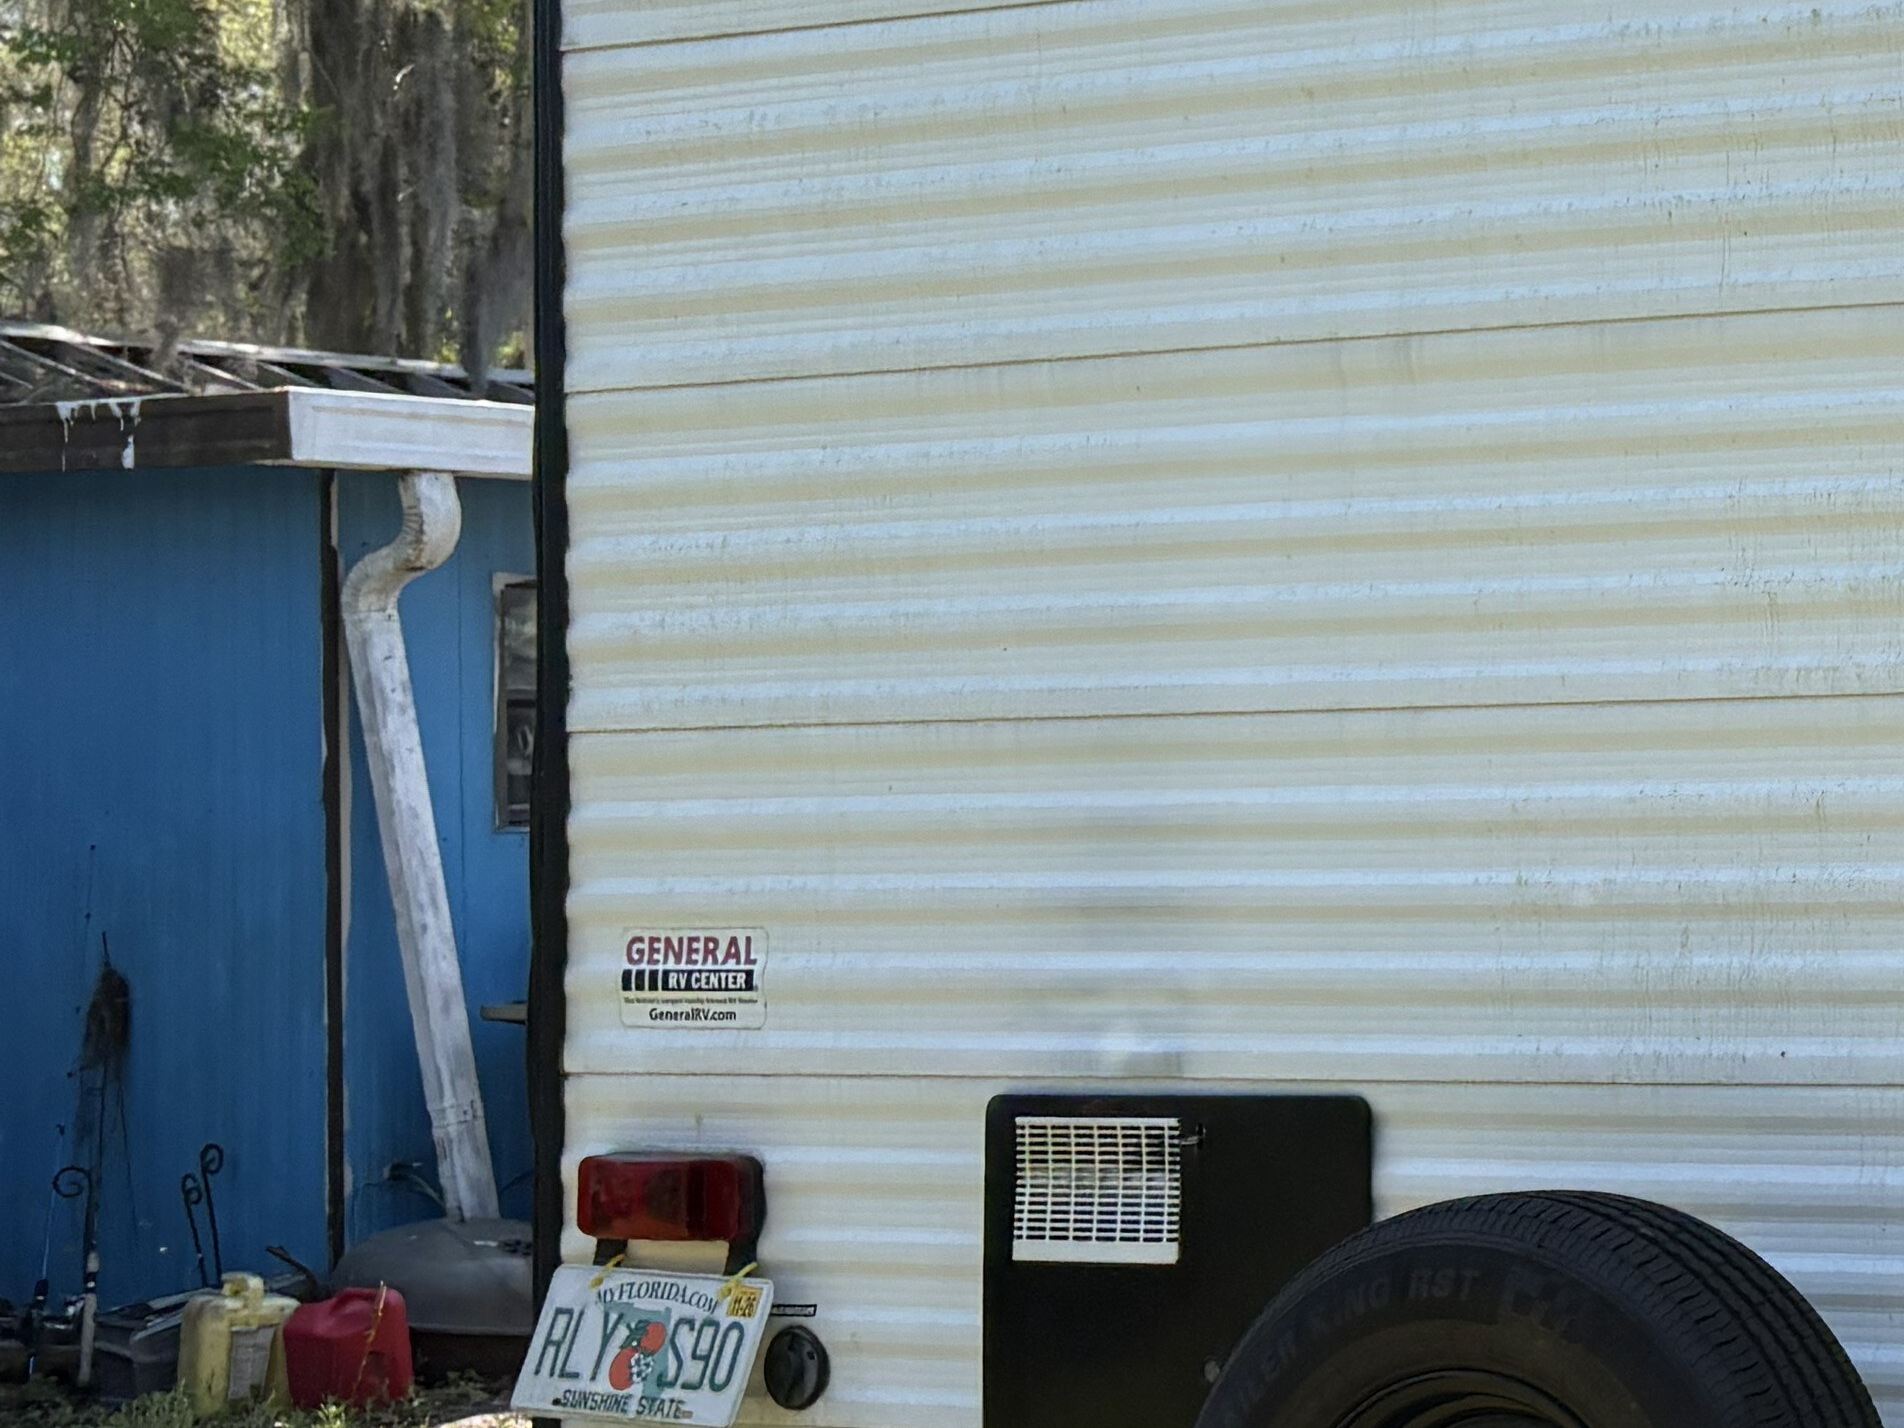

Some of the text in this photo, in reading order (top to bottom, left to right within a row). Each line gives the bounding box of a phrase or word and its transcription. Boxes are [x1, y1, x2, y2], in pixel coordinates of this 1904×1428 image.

[626, 935, 758, 966] GENERAL
[668, 972, 747, 990] RV CENTER
[649, 1007, 737, 1021] GeneralRV.com
[560, 1389, 686, 1420] SUNSHINE STATE
